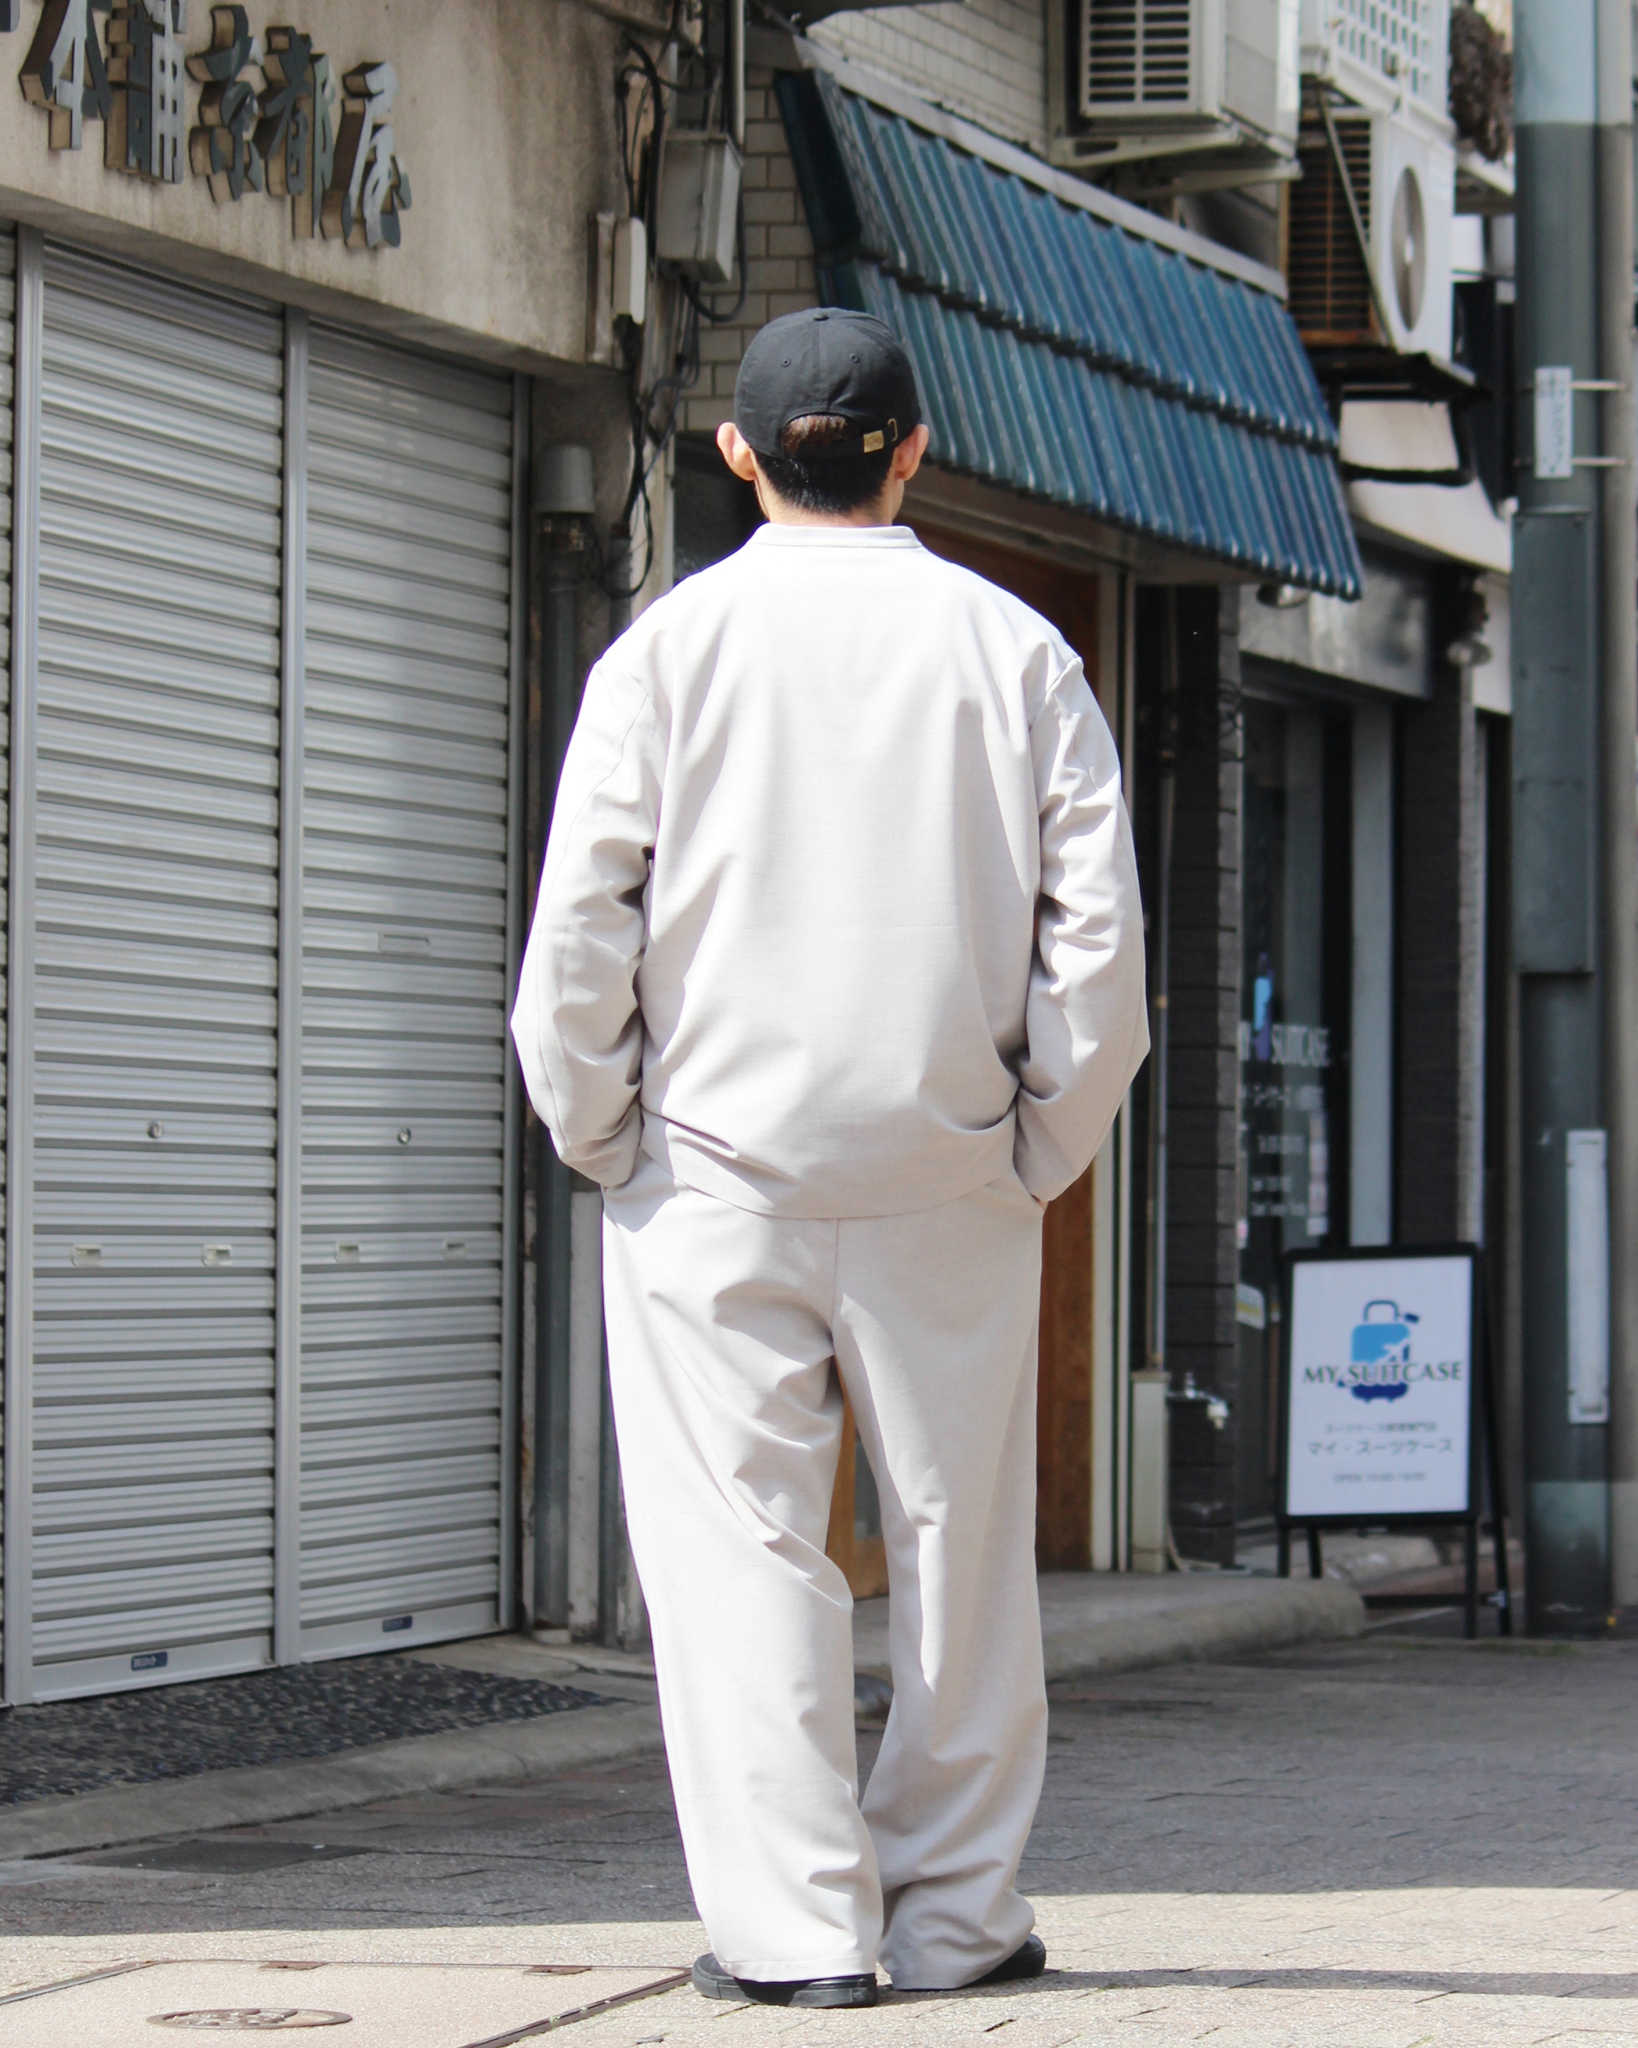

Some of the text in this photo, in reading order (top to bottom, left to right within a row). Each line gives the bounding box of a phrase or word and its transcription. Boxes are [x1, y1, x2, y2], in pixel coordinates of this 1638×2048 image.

[0, 0, 412, 248] 本舗京都屋
[1303, 1361, 1464, 1385] MY SUITCASE
